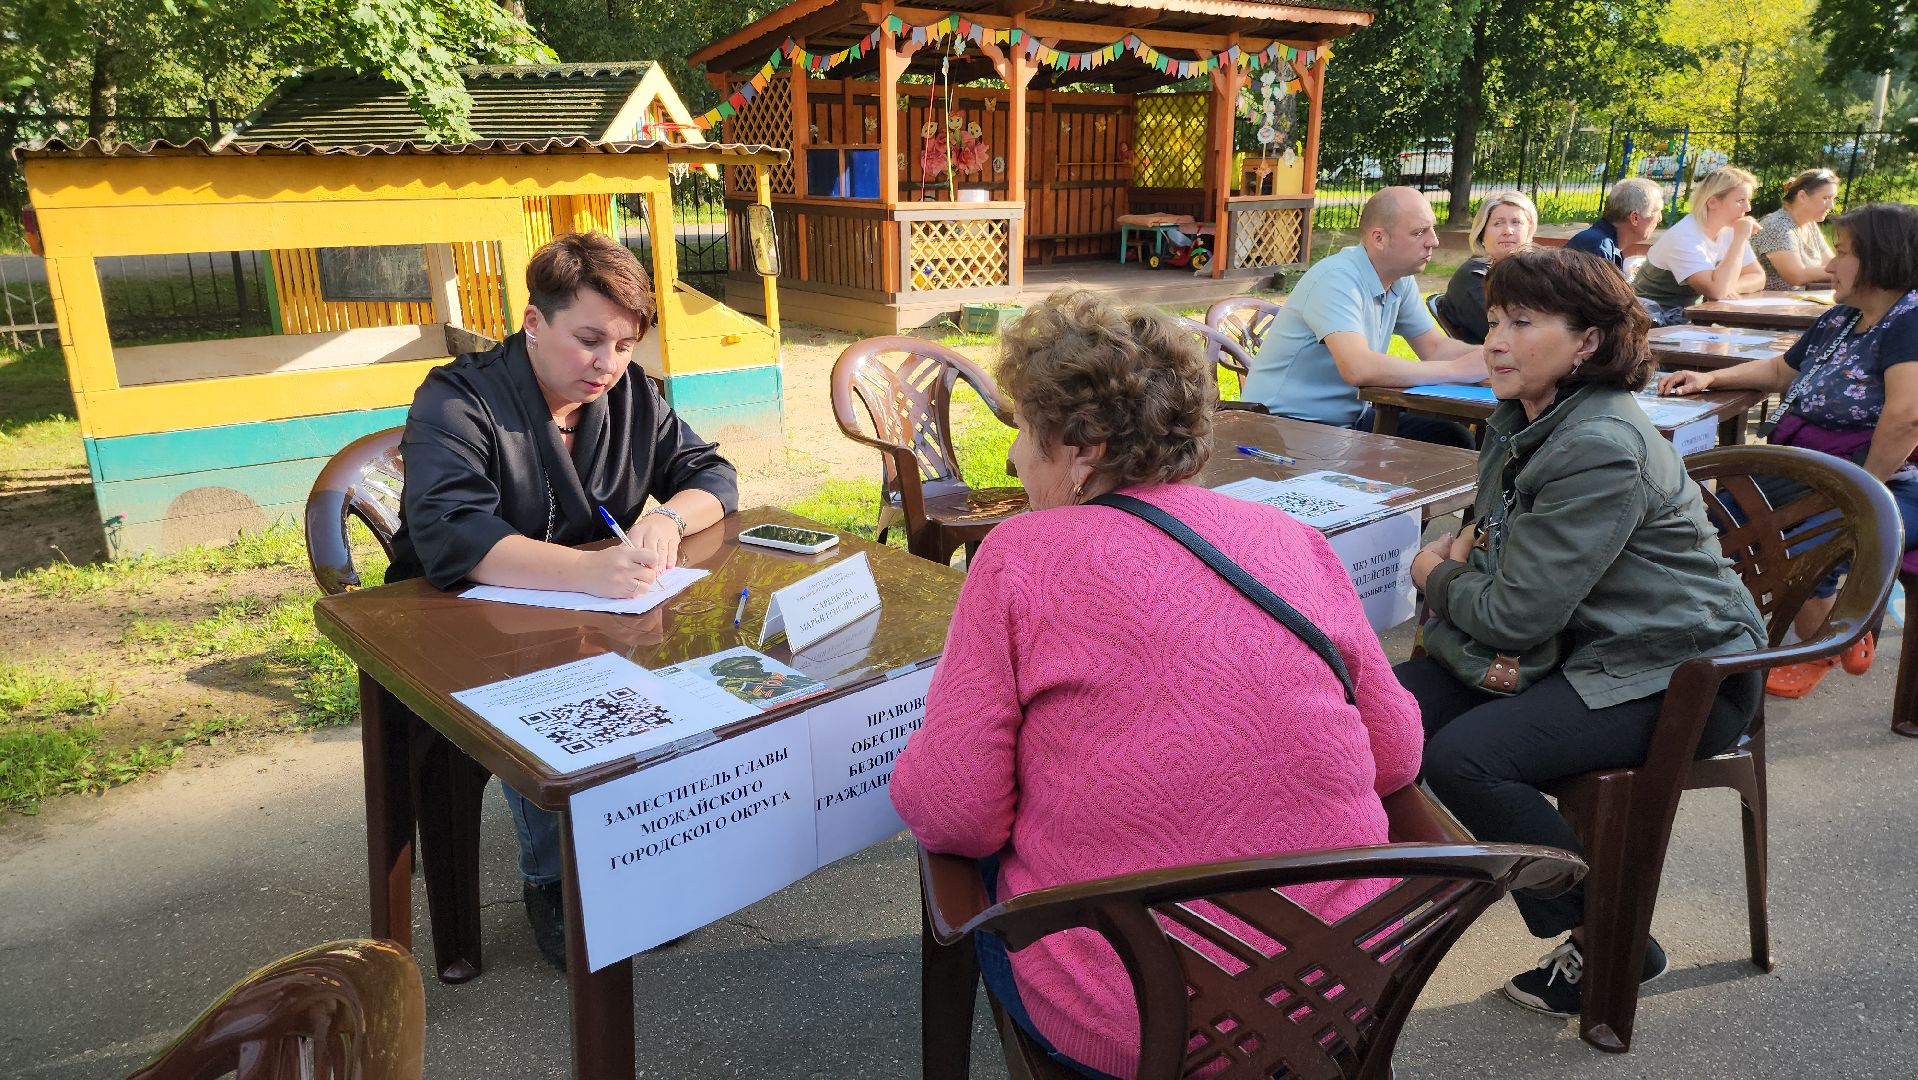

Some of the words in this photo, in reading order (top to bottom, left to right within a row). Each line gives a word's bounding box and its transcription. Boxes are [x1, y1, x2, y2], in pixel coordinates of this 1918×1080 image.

[1370, 553, 1387, 565] МГО
[1388, 548, 1400, 559] МО
[603, 771, 731, 827] ЗАМЕСТИТЕЛЬ
[735, 747, 788, 779] ГЛАВЫ
[849, 744, 907, 777] БЕЗОПА
[610, 816, 727, 870] ГОРОДСКОГО
[731, 790, 791, 823] ОКРУГА
[641, 779, 763, 836] МОЖАЙСКОГО
